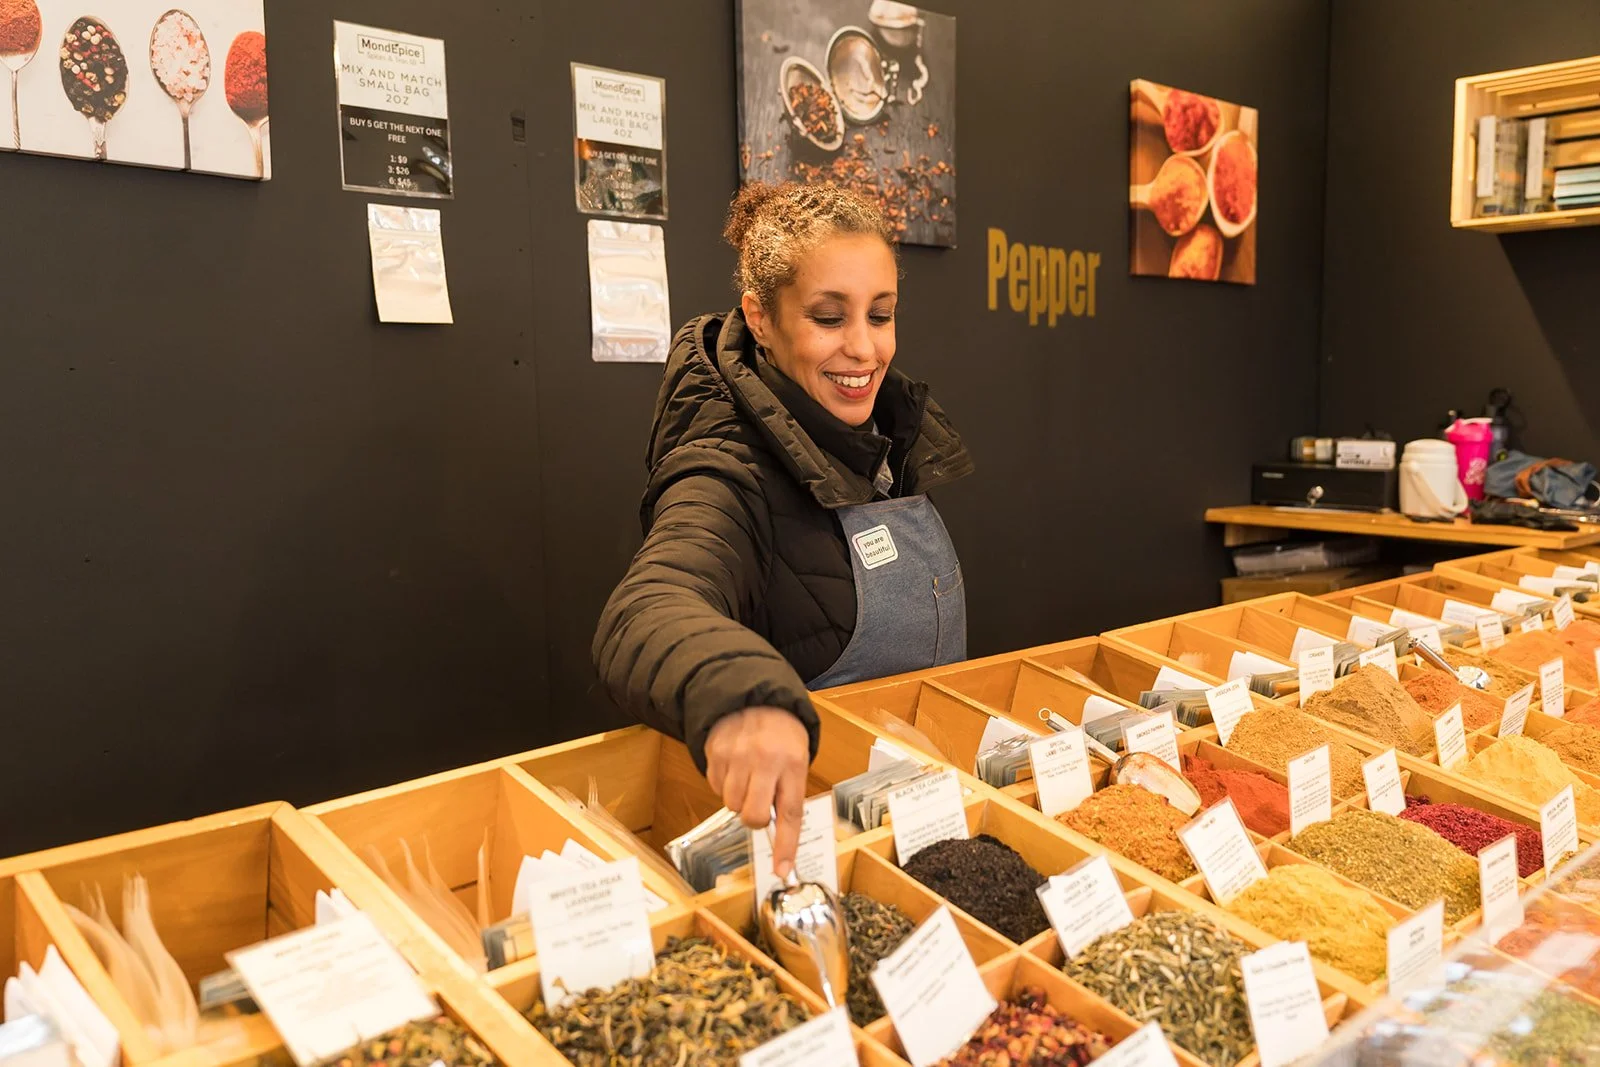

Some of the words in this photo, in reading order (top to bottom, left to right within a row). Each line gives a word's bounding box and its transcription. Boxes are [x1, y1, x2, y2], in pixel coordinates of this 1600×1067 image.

[342, 64, 363, 74] MIX
[370, 69, 395, 80] AND
[400, 73, 442, 87] MATCH
[359, 78, 399, 92] SMALL
[405, 86, 430, 97] BAG
[579, 102, 596, 111] MIX
[601, 106, 621, 116] AND
[625, 110, 658, 121] MATCH
[350, 118, 365, 126] BUY
[367, 120, 372, 128] 5
[374, 121, 388, 130] GET
[390, 122, 404, 132] THE
[406, 125, 424, 134] NEXT
[426, 128, 442, 137] ONE
[592, 115, 624, 127] LARGE
[629, 120, 648, 130] BAG
[388, 134, 406, 143] FREE
[988, 228, 1101, 327] Pepper
